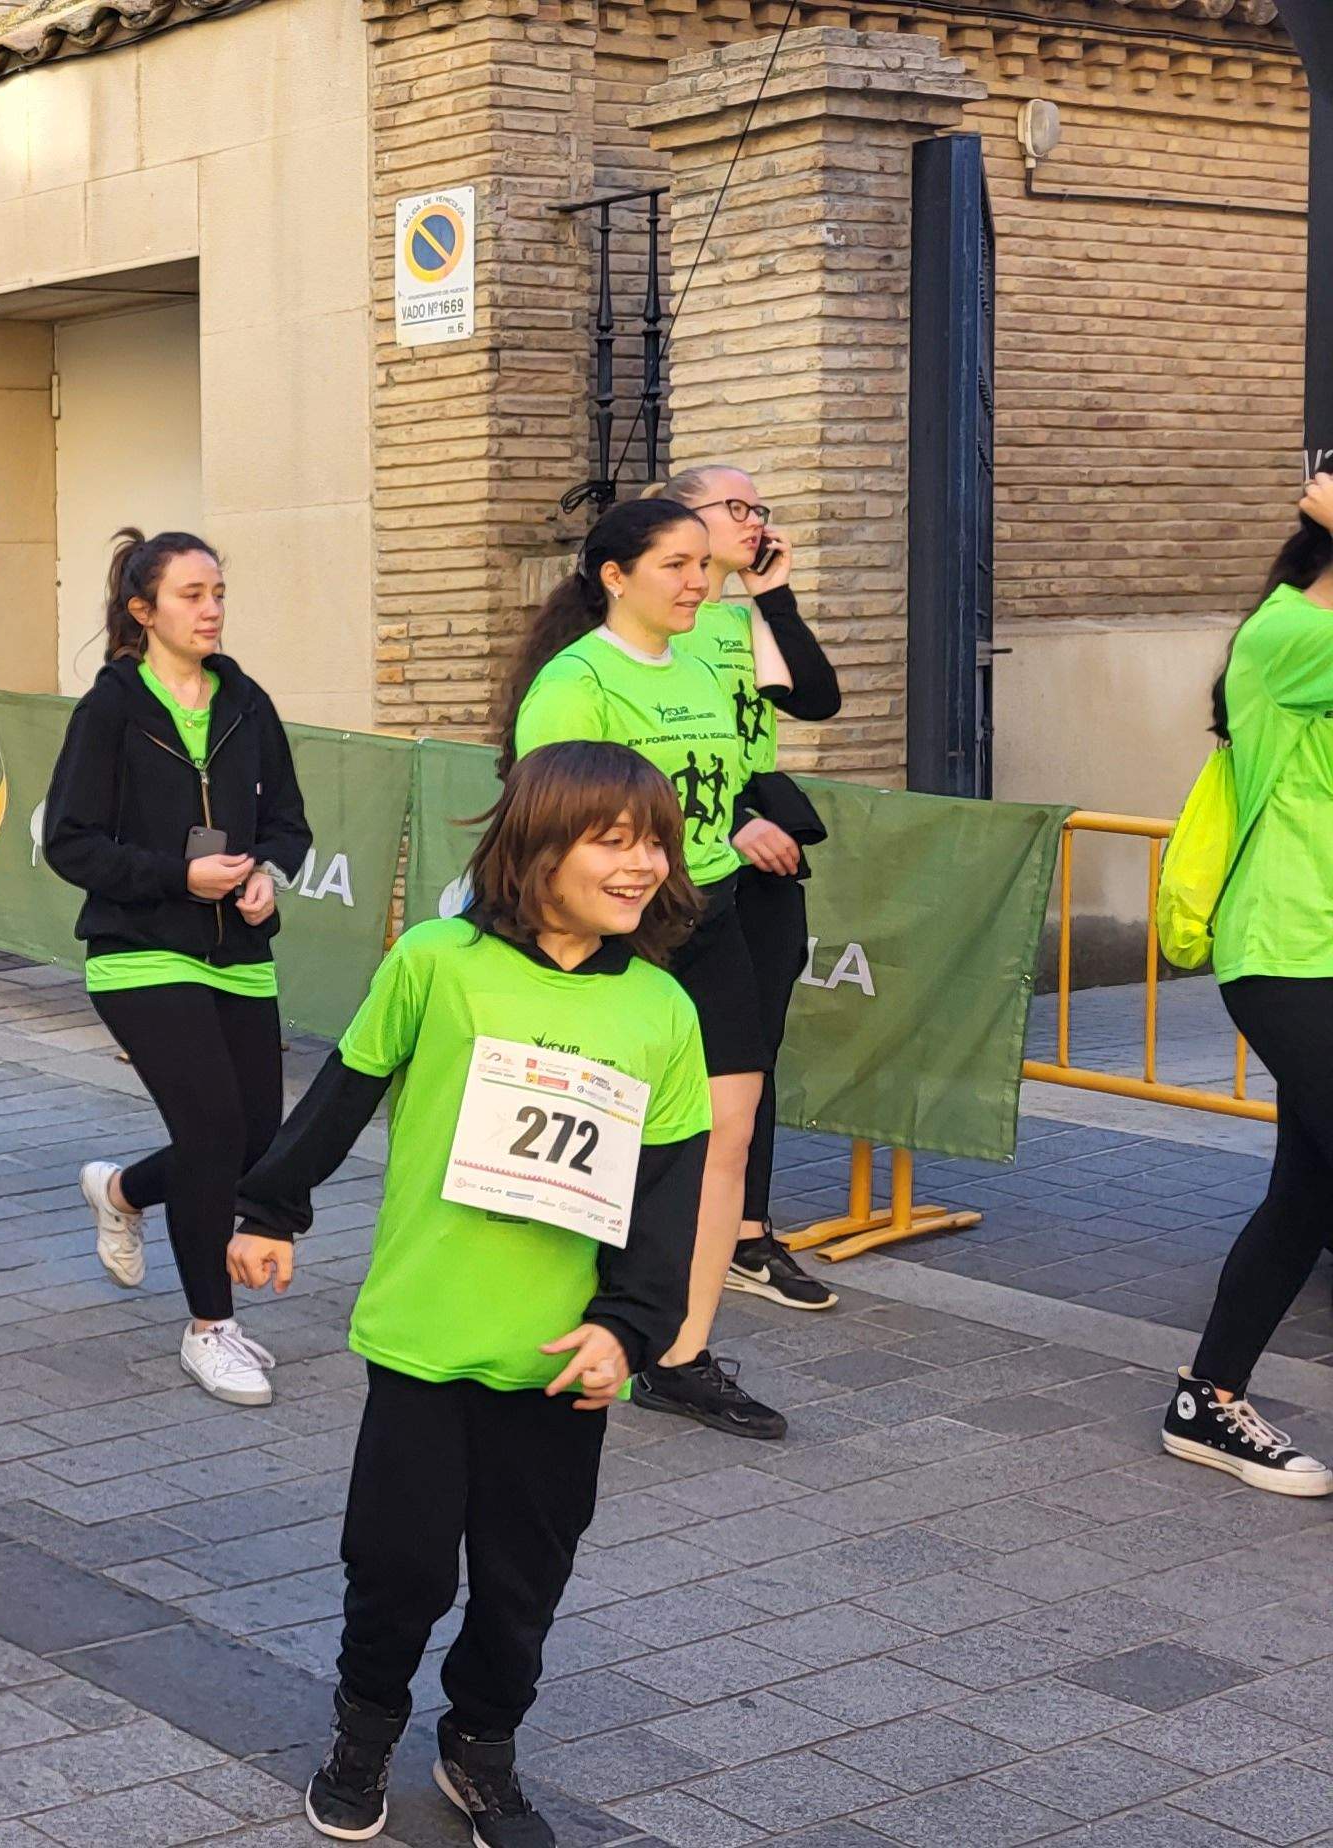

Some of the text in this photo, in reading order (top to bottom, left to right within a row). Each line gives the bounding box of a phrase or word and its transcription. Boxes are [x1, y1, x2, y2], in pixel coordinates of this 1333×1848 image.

[401, 303, 426, 320] VADO
[628, 739, 643, 747] EN
[645, 734, 681, 745] FORMA
[509, 1105, 599, 1176] 272
